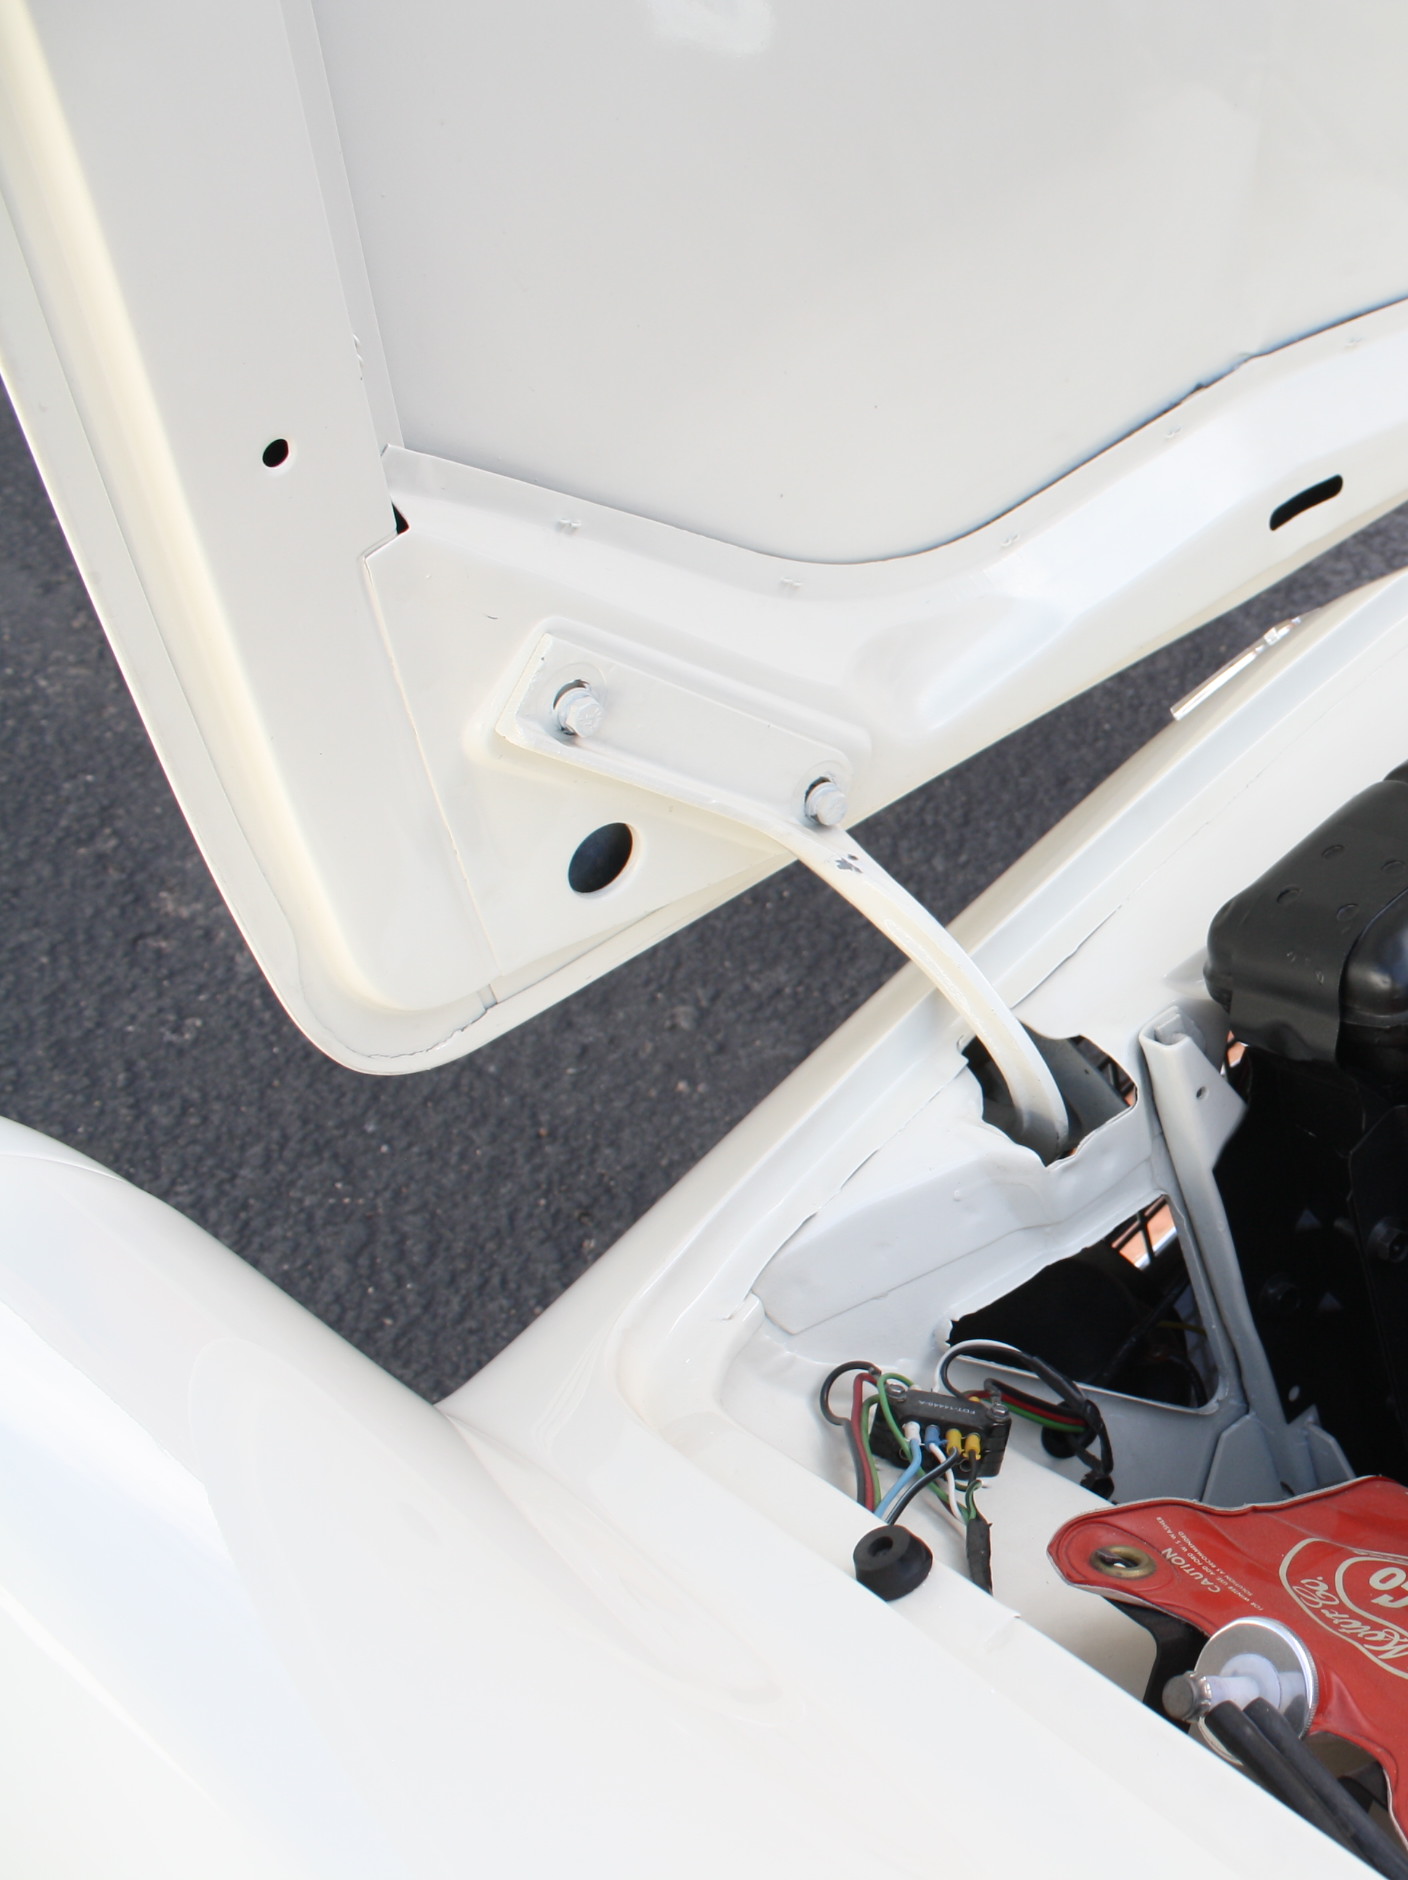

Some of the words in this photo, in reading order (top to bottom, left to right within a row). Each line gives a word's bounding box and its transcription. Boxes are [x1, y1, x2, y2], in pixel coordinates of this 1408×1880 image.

[1155, 1515, 1176, 1540] WASHER
[1177, 1530, 1216, 1569] RECOMMENDED
[1186, 1551, 1203, 1566] FORD
[1161, 1547, 1221, 1592] CAUTION
[1201, 1564, 1216, 1576] ADD
[1227, 1584, 1250, 1602] WINTER
[1250, 1600, 1263, 1611] FOR
